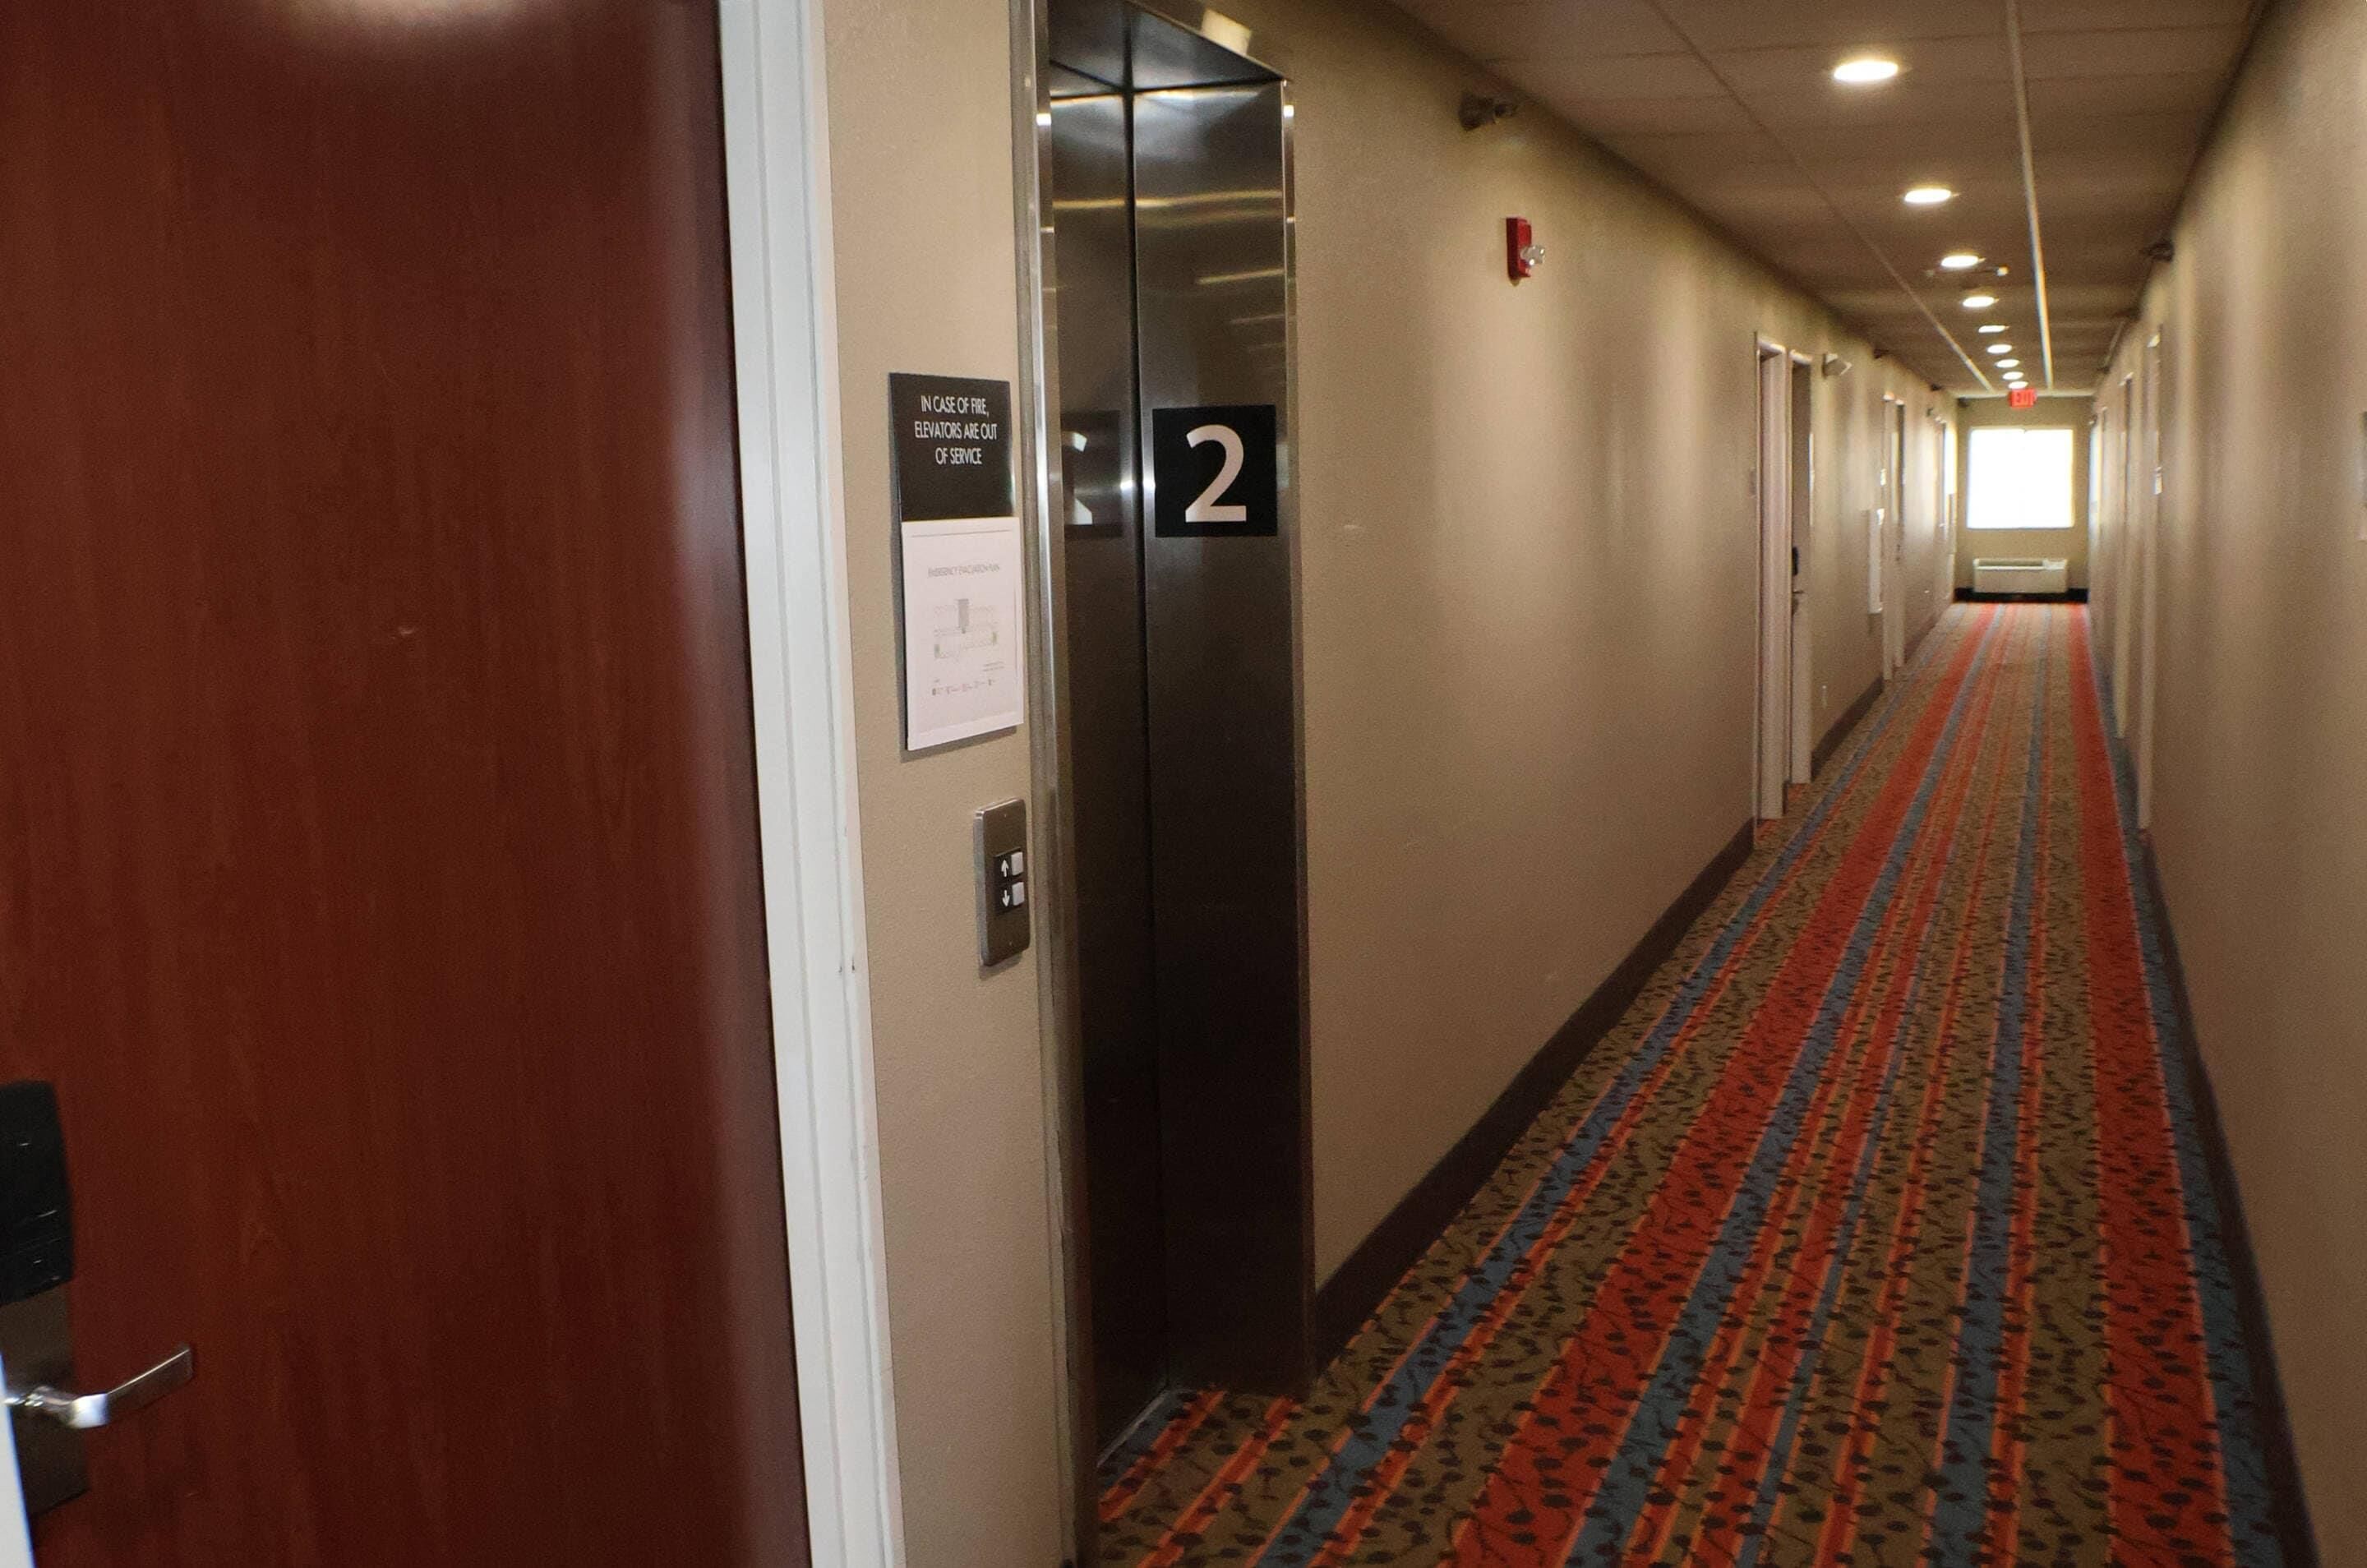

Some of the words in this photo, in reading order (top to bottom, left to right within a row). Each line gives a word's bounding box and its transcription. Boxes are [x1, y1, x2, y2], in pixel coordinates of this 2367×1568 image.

[920, 395, 931, 412] IN
[933, 396, 956, 413] CASE
[957, 397, 969, 414] OF
[914, 421, 962, 439] ELEVATORS
[963, 422, 980, 440] ARE
[980, 423, 997, 440] OUT
[935, 447, 948, 465] OF
[949, 447, 982, 464] SERVICE
[1185, 424, 1247, 523] 2
